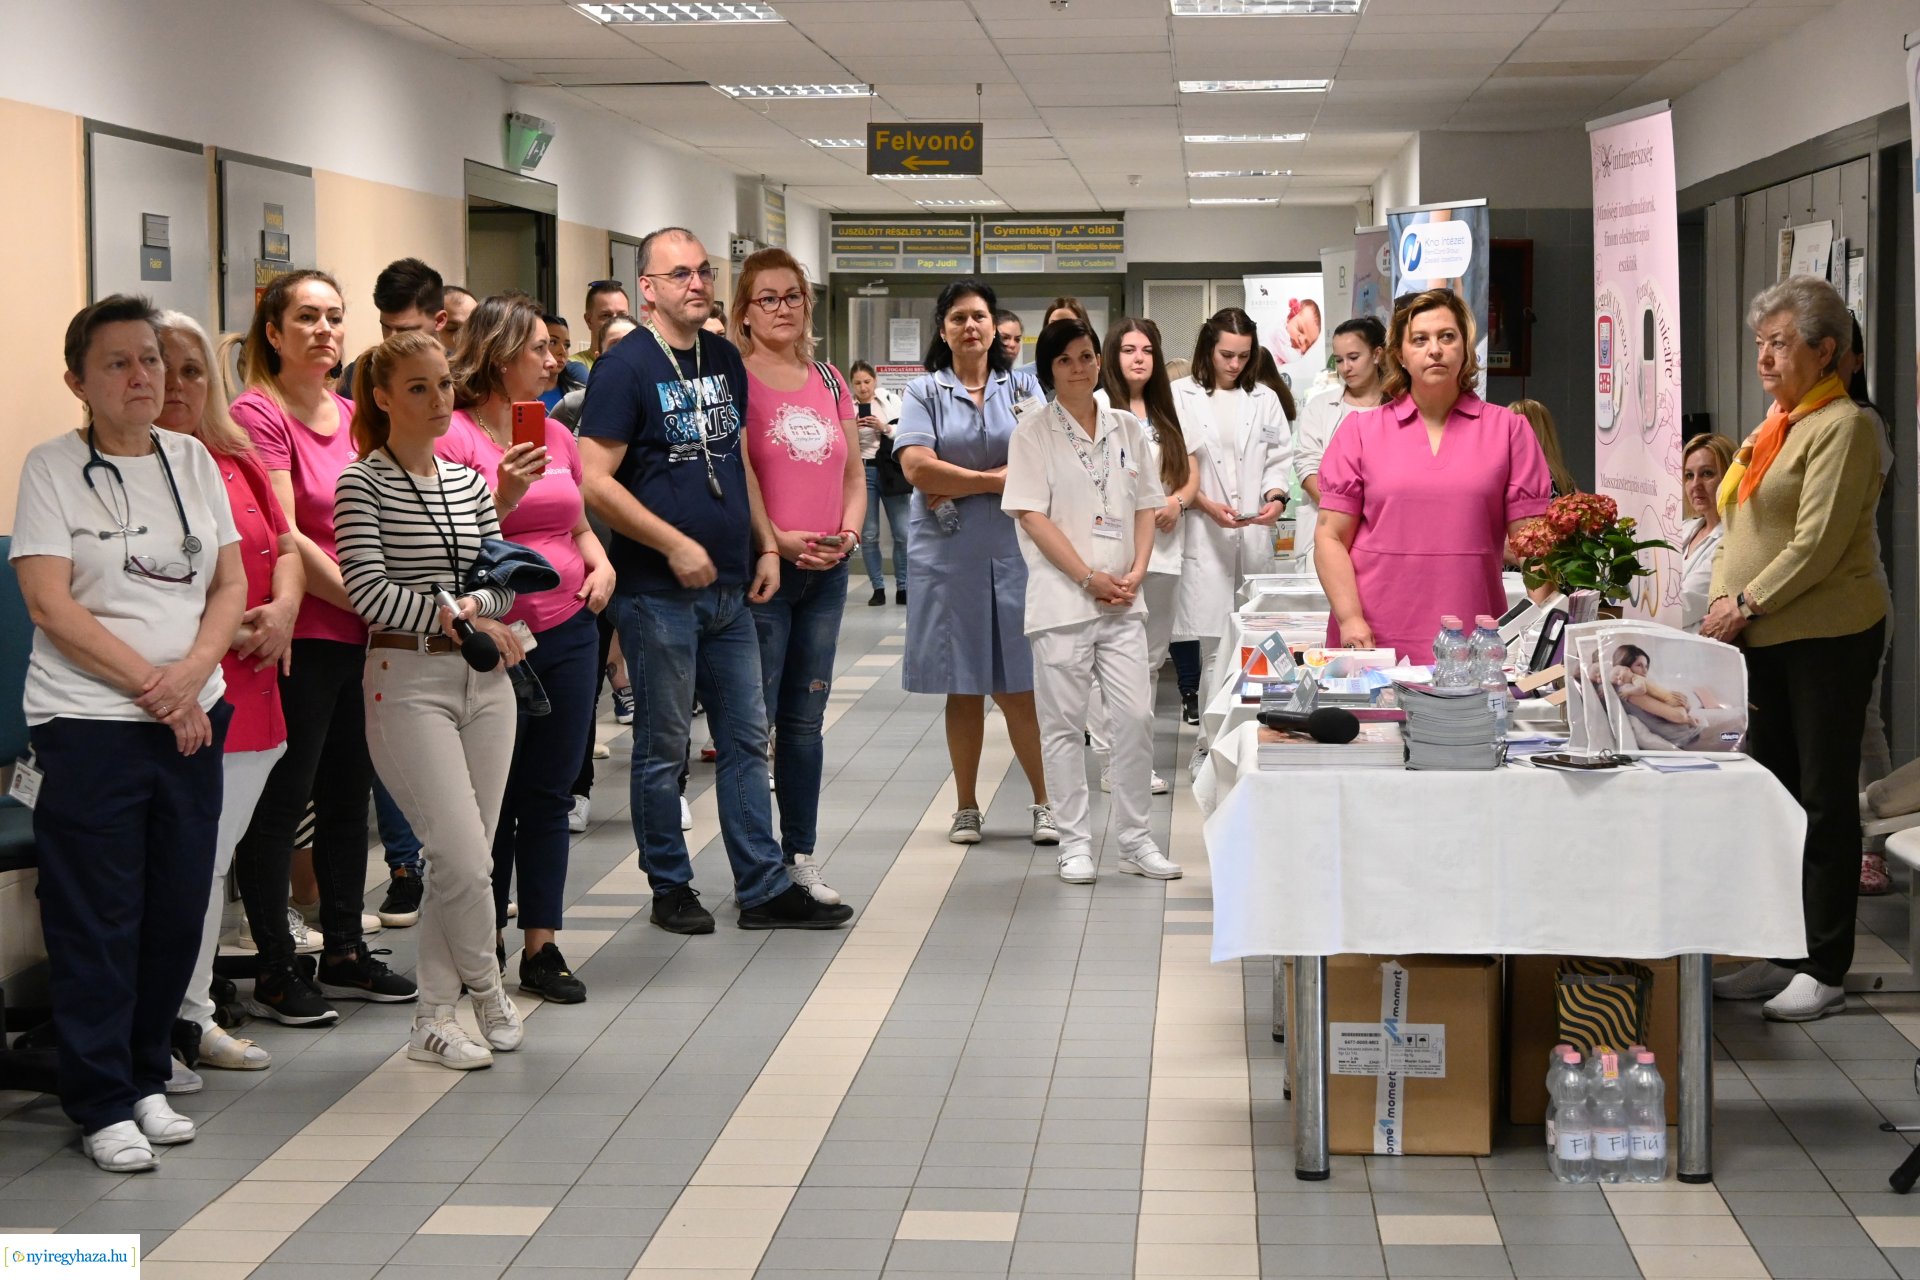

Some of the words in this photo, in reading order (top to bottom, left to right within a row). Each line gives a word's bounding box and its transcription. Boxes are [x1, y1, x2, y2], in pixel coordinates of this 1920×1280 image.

[876, 130, 974, 151] Felvonó
[885, 227, 922, 236] RÉSZLEG
[938, 228, 965, 236] OLDAL
[993, 225, 1063, 237] Gyermekágy
[1088, 225, 1115, 235] oldal
[917, 259, 934, 268] Pap
[935, 259, 957, 267] Judit
[1393, 970, 1403, 1018] momert
[1386, 1070, 1397, 1119] momert
[1632, 1135, 1660, 1151] Fiú
